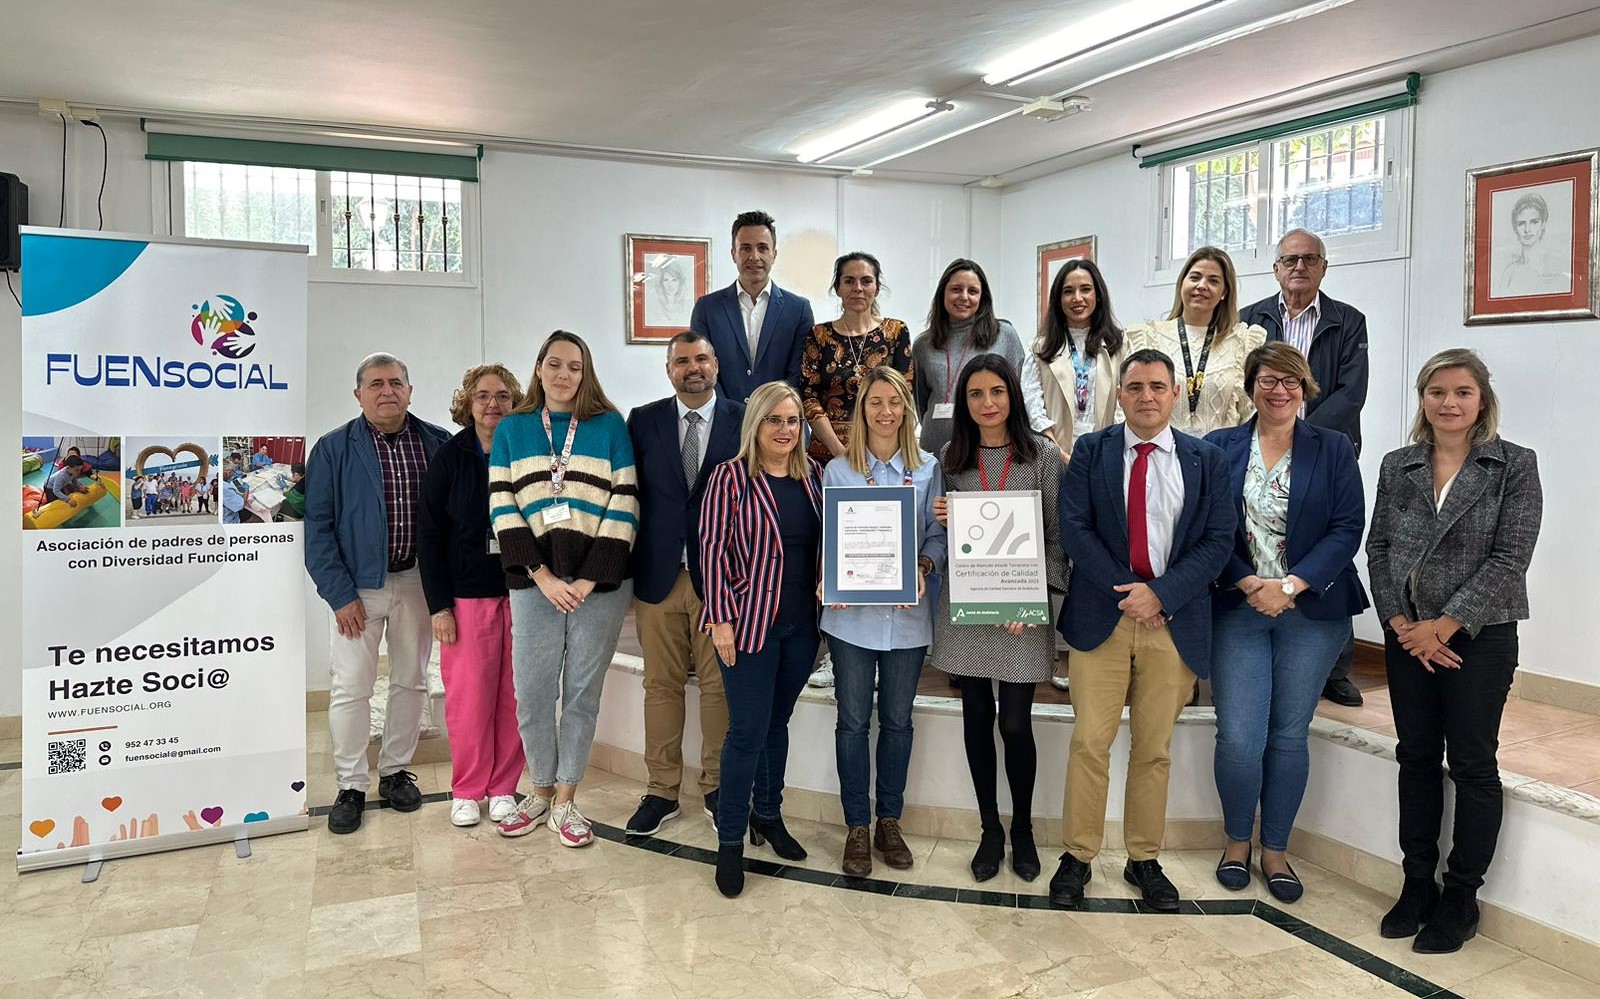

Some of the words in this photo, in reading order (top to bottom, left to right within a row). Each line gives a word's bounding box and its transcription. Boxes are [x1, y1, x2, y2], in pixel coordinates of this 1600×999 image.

[47, 353, 288, 390] FUENSOCIAL
[36, 537, 125, 552] Asociación
[128, 536, 148, 549] de
[151, 535, 204, 551] padres
[207, 534, 226, 547] de
[229, 533, 295, 548] personas
[68, 558, 98, 569] con
[102, 553, 184, 568] Diversidad
[187, 550, 259, 564] Funcional
[1001, 569, 1010, 577] de
[1011, 569, 1038, 577] Calidad
[48, 646, 85, 666] Te
[96, 636, 274, 663] necesitamos
[50, 677, 133, 700] Hazte
[143, 668, 229, 692] Soci@
[48, 701, 171, 719] WWW.FUENSOCIAL.ORG
[125, 740, 141, 748] 952
[143, 739, 154, 747] 47
[156, 738, 166, 746] 33
[125, 746, 221, 762] fuensocial@gmail.com
